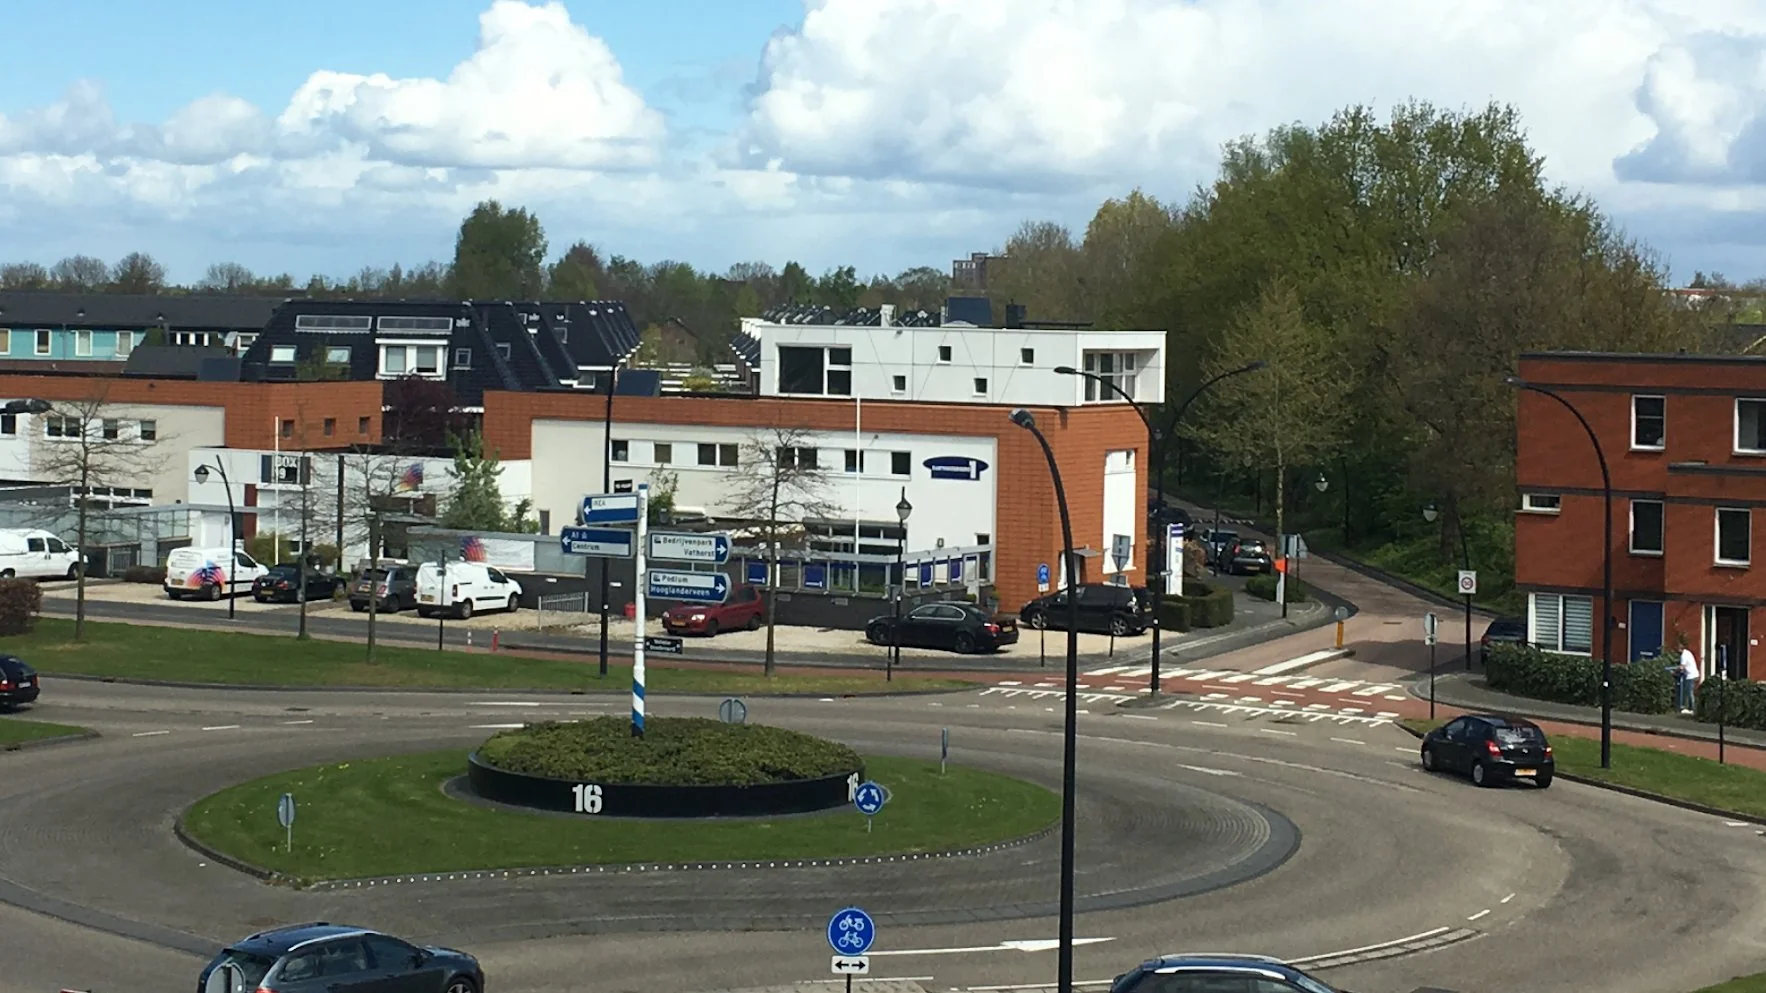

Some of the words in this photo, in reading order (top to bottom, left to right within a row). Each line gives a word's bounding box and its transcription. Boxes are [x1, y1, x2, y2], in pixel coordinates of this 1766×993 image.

[571, 531, 579, 539] A1
[662, 536, 713, 546] Bedrijvenpark
[572, 543, 600, 551] Centrum
[684, 548, 715, 557] Vathorst
[662, 574, 688, 583] Podium
[650, 585, 711, 597] Hooglanderveen
[572, 783, 603, 814] 16
